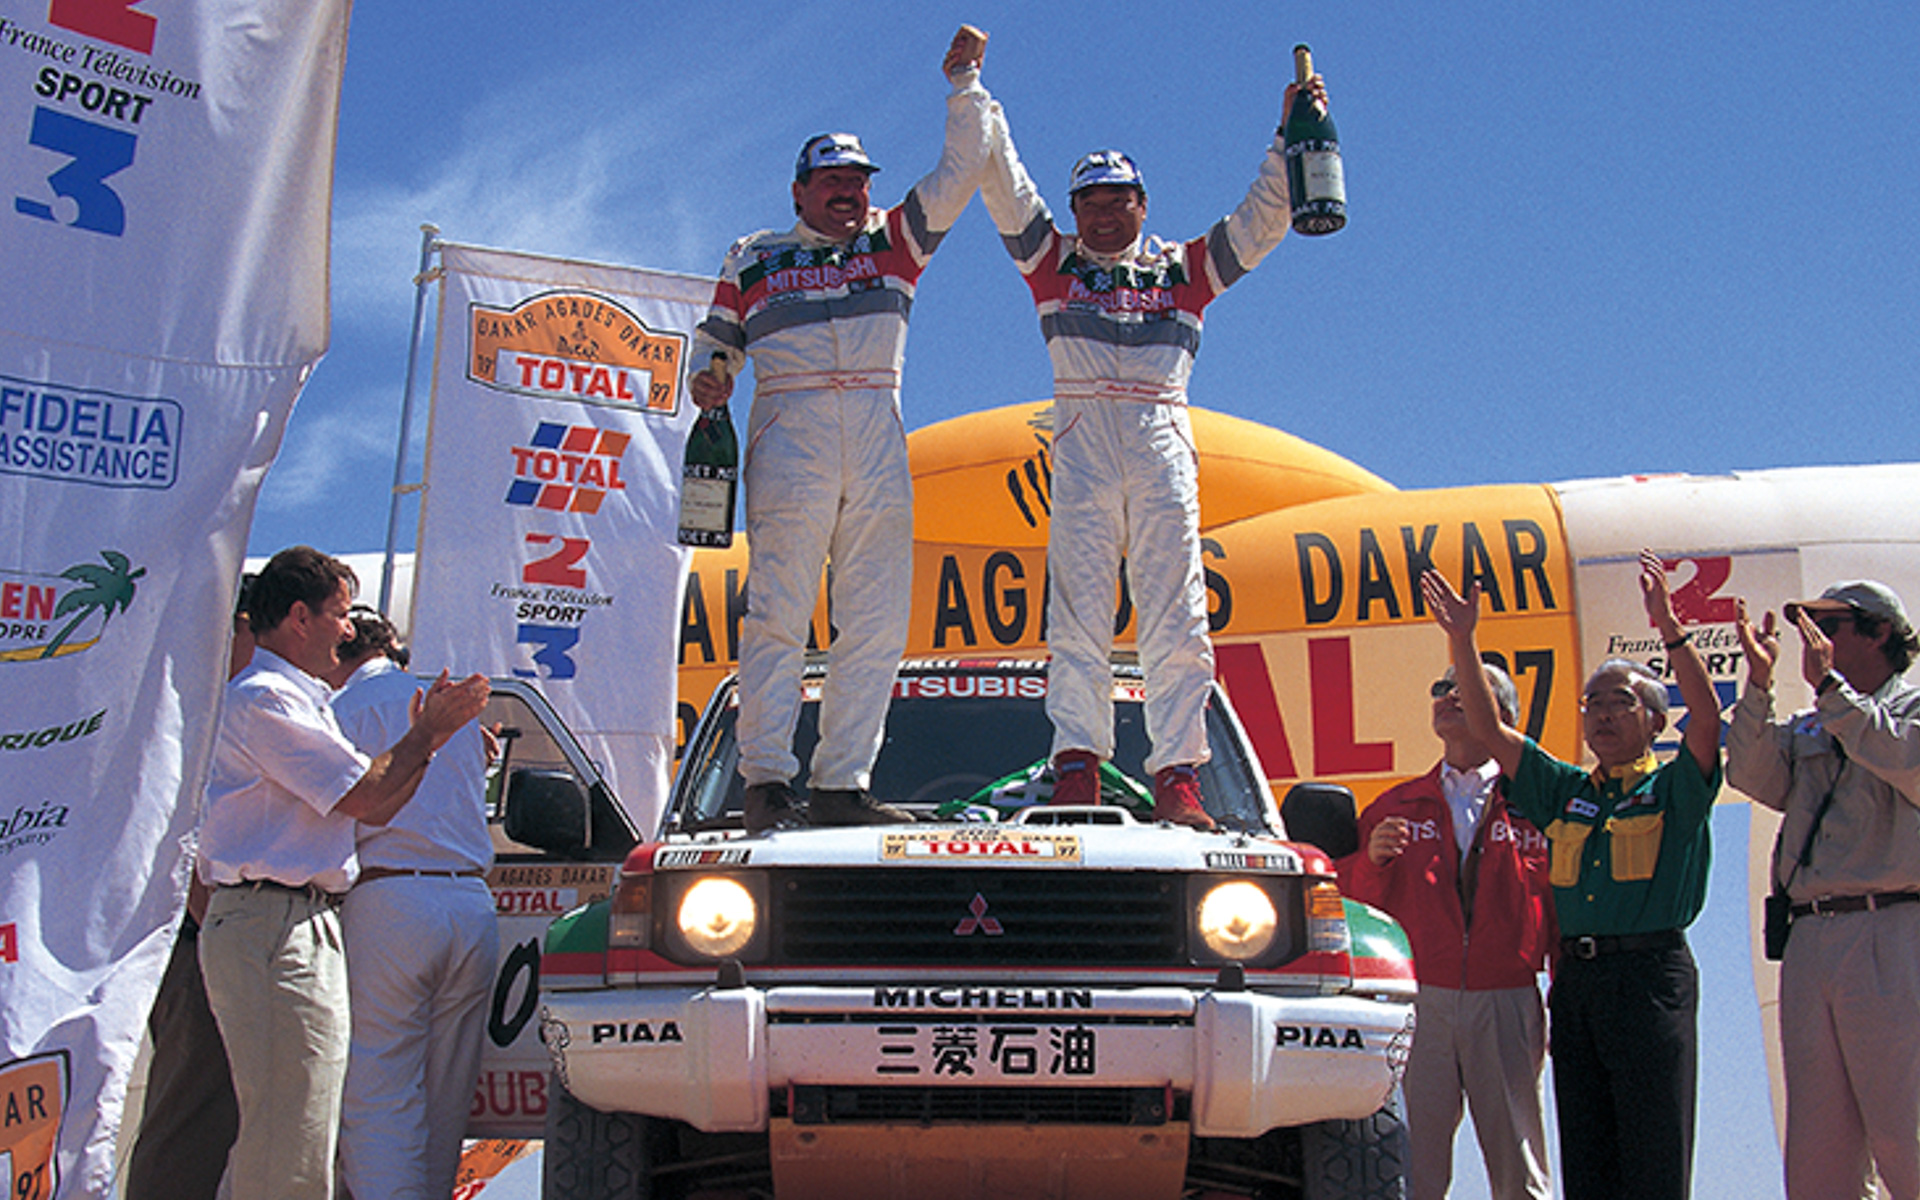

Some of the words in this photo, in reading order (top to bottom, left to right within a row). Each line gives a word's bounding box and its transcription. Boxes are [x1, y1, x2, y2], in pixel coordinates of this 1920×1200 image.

[0, 19, 77, 63] France
[80, 44, 201, 100] Télévision
[34, 67, 153, 125] SPORT
[15, 105, 138, 237] 3
[478, 312, 537, 339] DAKAR
[545, 300, 616, 328] AGADES
[619, 325, 674, 363] DAKAR
[516, 356, 633, 400] TOTAL
[0, 388, 171, 446] FIDELIA
[0, 432, 169, 480] ASSISTANCE
[511, 447, 626, 489] TOTAL
[522, 532, 591, 589] 2
[490, 583, 540, 600] France
[516, 603, 587, 622] SPORT
[512, 623, 580, 680] 3
[1607, 634, 1668, 655] Franc
[889, 676, 1046, 698] TSUBIS
[925, 841, 1040, 855] TOTAL
[874, 988, 1093, 1009] MICHELIN
[592, 1022, 683, 1043] PIAA
[876, 1024, 1096, 1075] 三菱石油
[1276, 1026, 1365, 1049] PIAA
